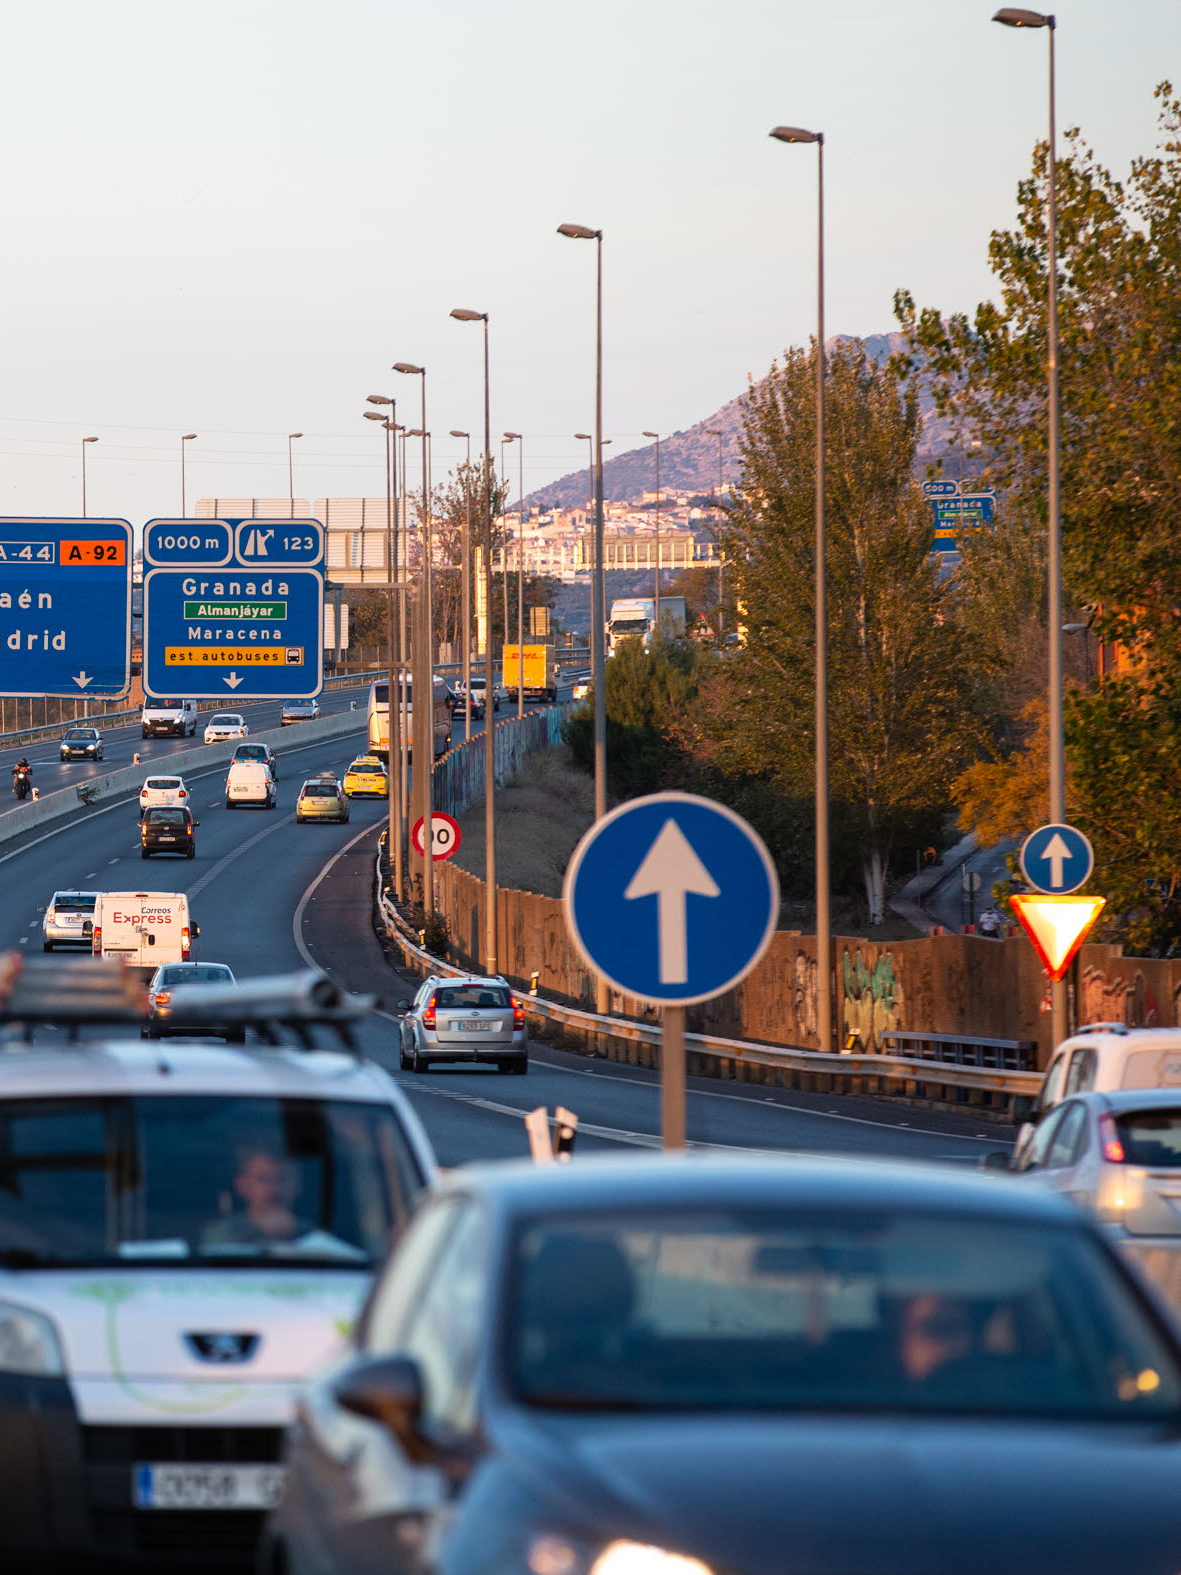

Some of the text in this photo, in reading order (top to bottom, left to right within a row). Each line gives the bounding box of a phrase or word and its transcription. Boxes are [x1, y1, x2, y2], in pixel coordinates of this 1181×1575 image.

[157, 535, 219, 550] 1000 m
[283, 537, 314, 550] 123
[68, 545, 118, 561] A-92
[182, 577, 289, 596] Granada
[197, 604, 274, 619] Almanjáyar
[188, 626, 282, 640] Maracena
[170, 650, 279, 661] est. autobuses
[141, 906, 171, 914] Correos
[113, 912, 172, 926] Express
